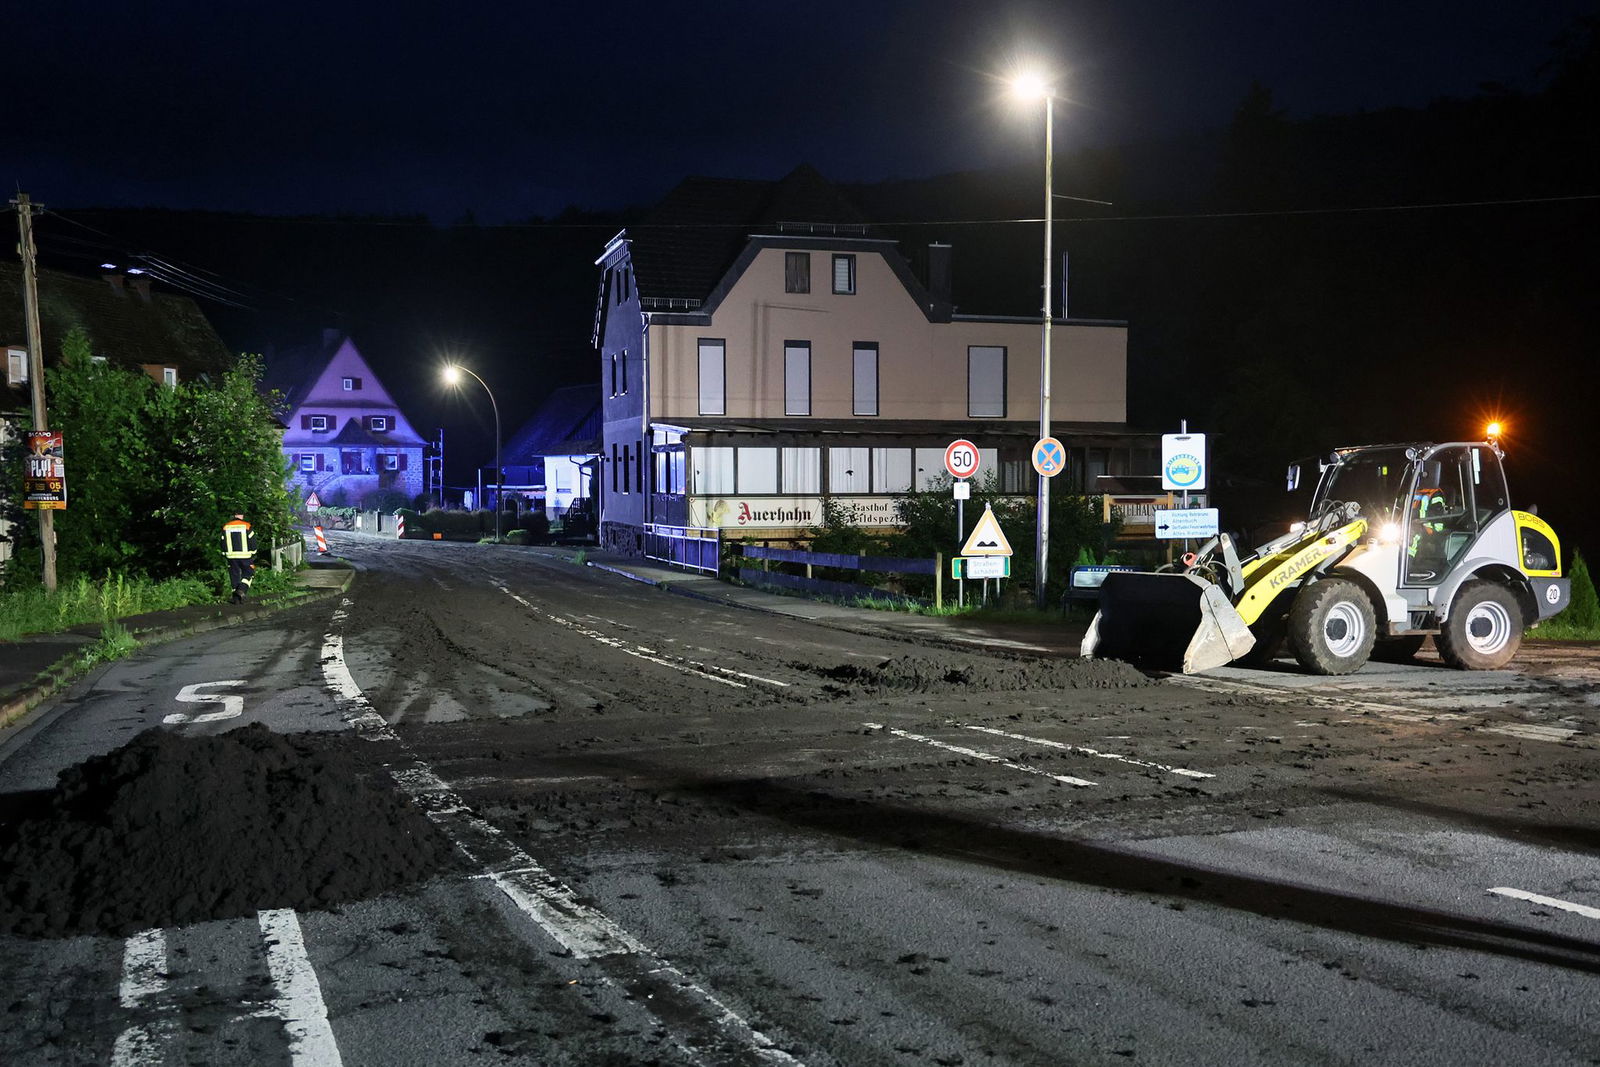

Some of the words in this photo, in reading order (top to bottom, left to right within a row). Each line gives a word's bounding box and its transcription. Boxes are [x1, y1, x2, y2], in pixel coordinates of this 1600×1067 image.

[953, 451, 972, 467] 50
[31, 459, 51, 477] FLY!
[738, 501, 812, 526] Auerhahn
[852, 502, 889, 511] Gasthof
[1270, 548, 1322, 589] KRAMER
[1549, 589, 1558, 600] 20
